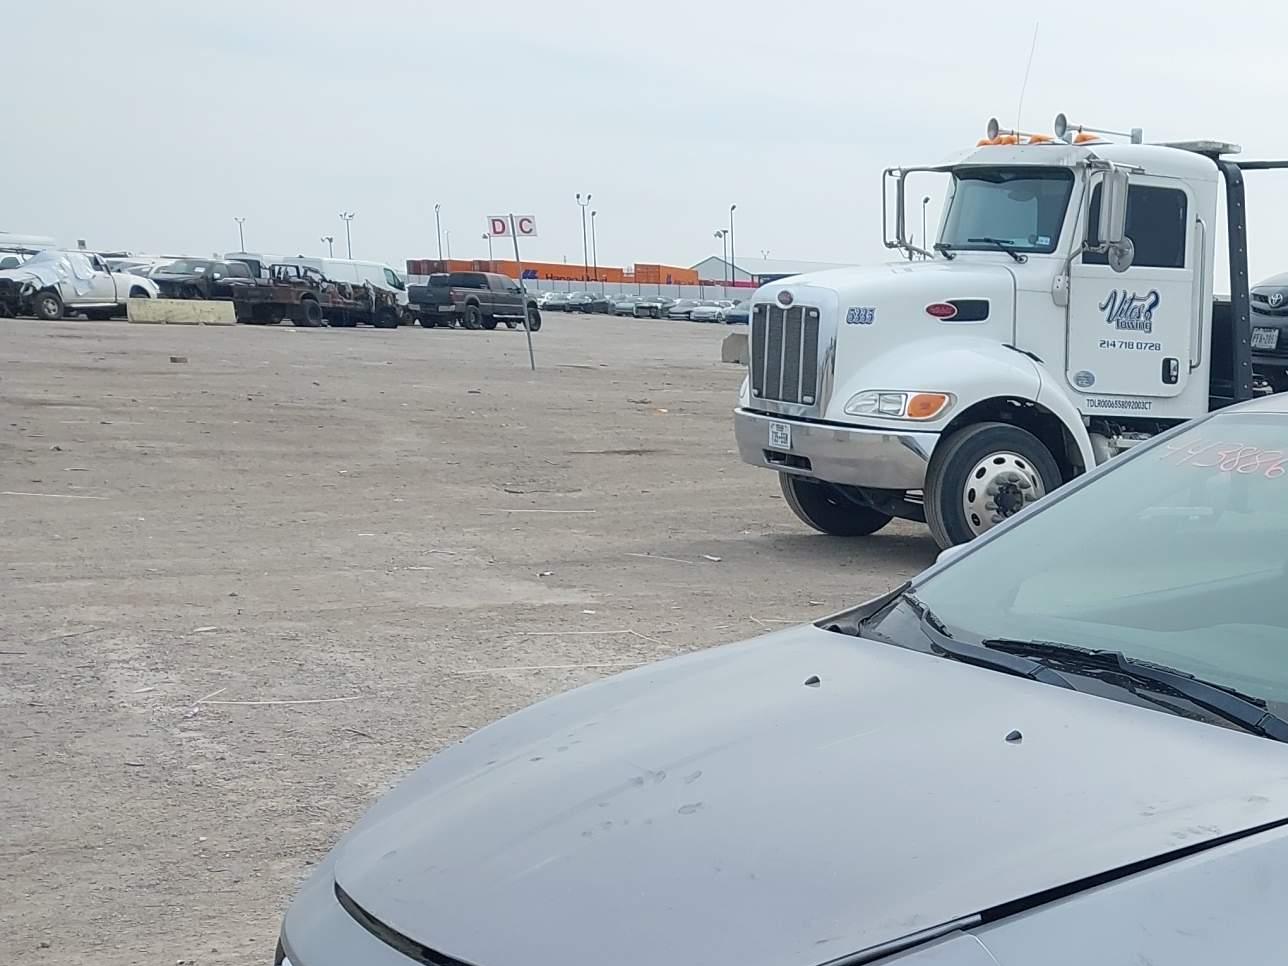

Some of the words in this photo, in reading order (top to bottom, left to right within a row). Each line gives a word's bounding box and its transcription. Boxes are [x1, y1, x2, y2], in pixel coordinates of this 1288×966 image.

[491, 218, 506, 235] D
[518, 218, 533, 234] C
[1099, 339, 1116, 349] 214
[1118, 340, 1134, 350] 718
[1136, 341, 1161, 351] 0728
